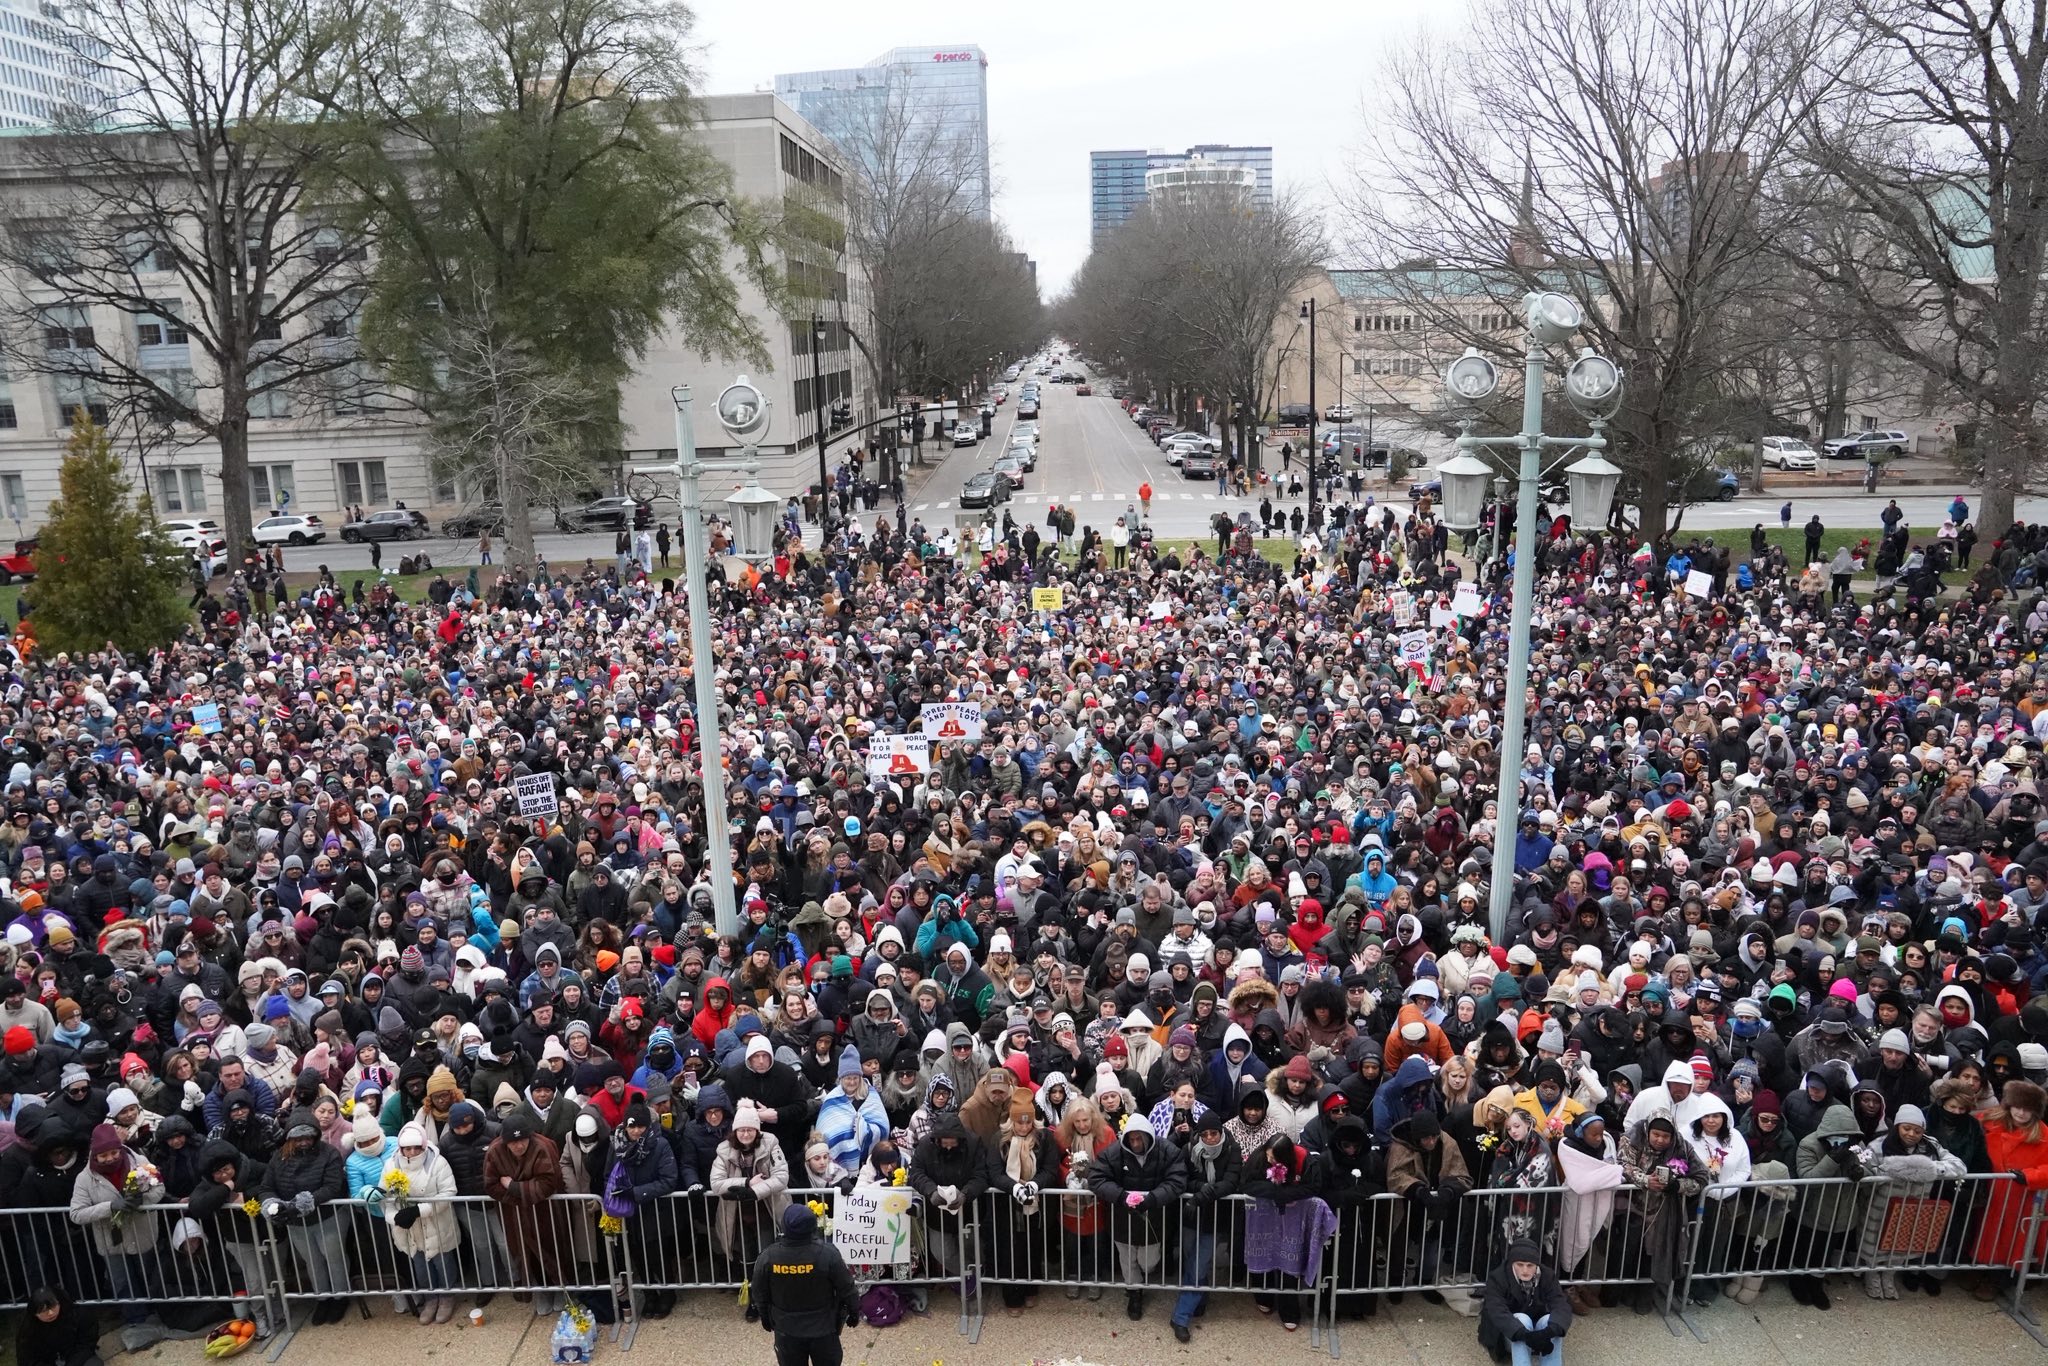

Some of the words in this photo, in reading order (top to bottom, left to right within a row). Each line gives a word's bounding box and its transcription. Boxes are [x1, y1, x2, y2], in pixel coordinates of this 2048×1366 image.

[942, 51, 972, 63] pendo
[1407, 652, 1425, 661] IRAN
[922, 704, 952, 719] SPREAD
[955, 704, 981, 718] PEACE
[929, 712, 945, 722] AND
[959, 713, 980, 723] LOVE
[517, 777, 538, 787] HANDS
[539, 774, 550, 783] OFF
[518, 782, 552, 797] RAFAH!
[522, 797, 539, 808] STOP
[540, 795, 553, 804] THE
[521, 802, 557, 815] GENOCIDE!
[845, 1193, 877, 1213] Today
[845, 1211, 854, 1221] is
[859, 1215, 876, 1228] my
[835, 1229, 889, 1245] PEACEFUL
[850, 1248, 878, 1260] DAY!
[773, 1264, 814, 1275] NCSCP
